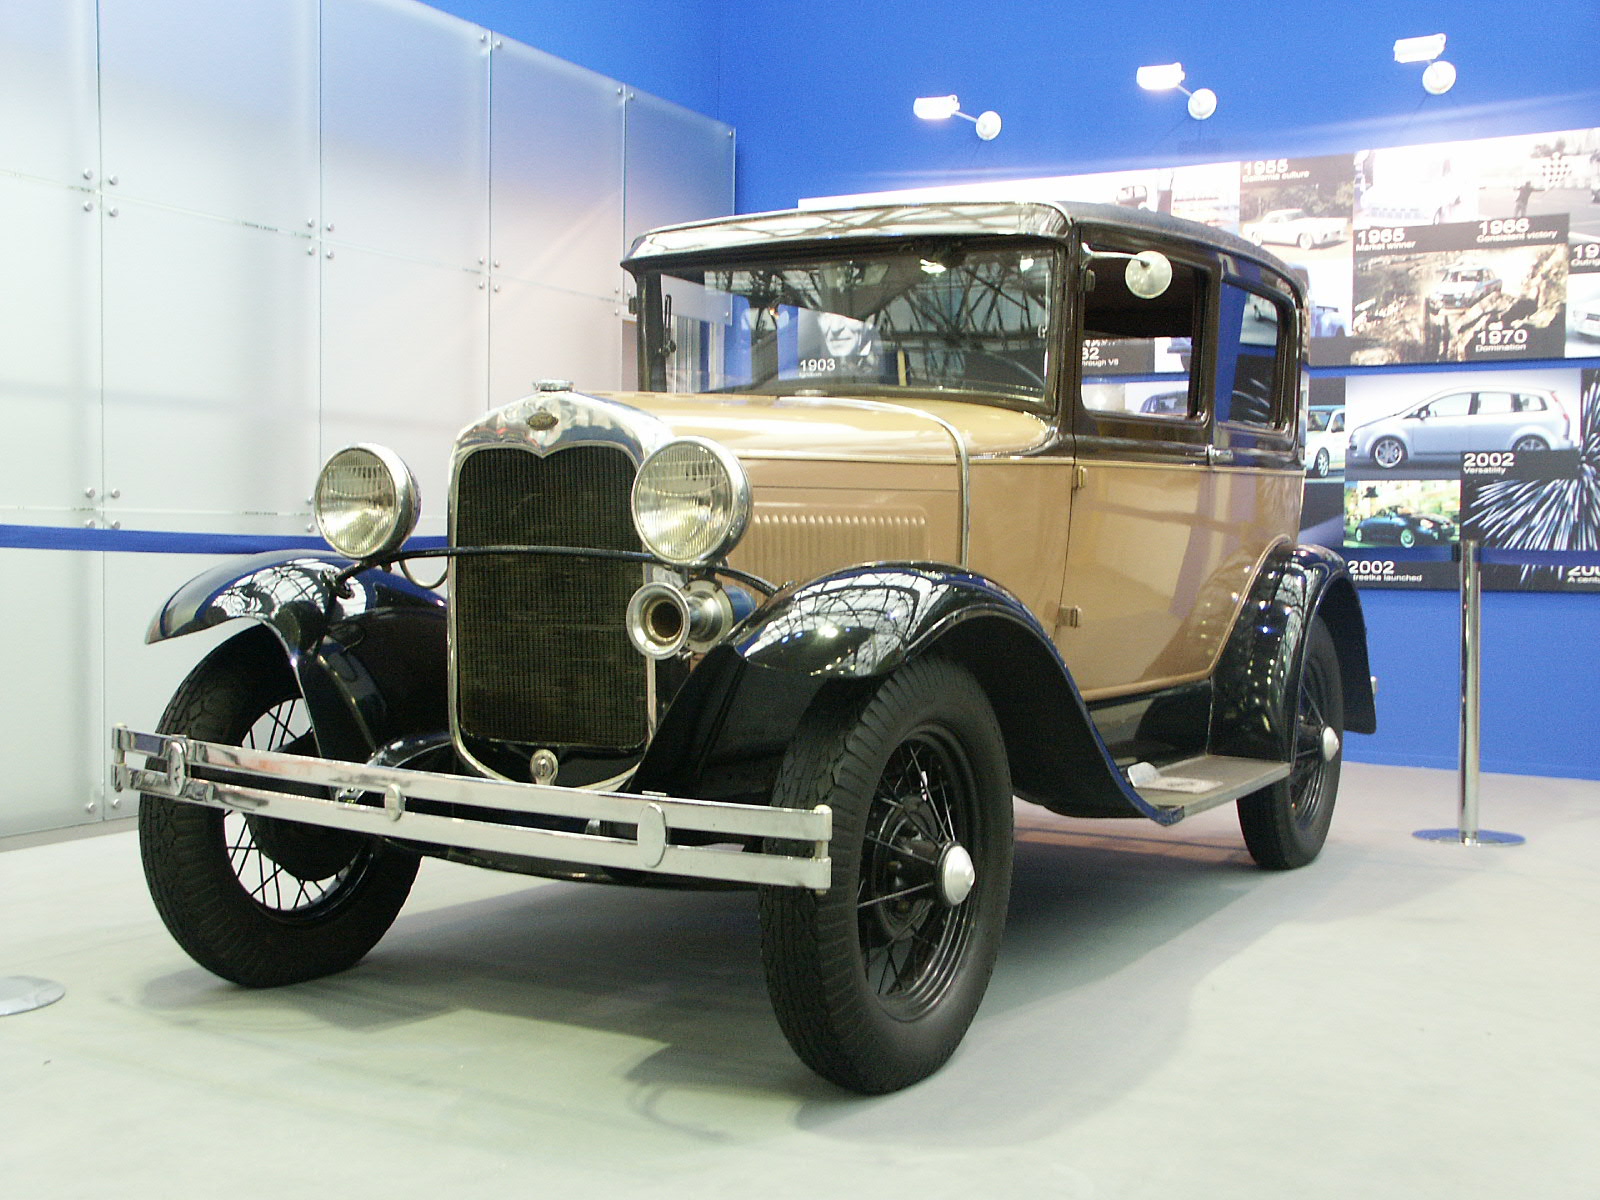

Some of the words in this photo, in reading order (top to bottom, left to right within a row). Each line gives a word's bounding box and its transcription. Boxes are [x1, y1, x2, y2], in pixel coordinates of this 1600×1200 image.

[1479, 218, 1530, 235] 1966
[1476, 232, 1526, 243] Consistent
[1526, 230, 1558, 239] victory
[1355, 242, 1386, 252] Market
[1386, 240, 1417, 250] winner
[1477, 329, 1527, 345] 1970
[1475, 343, 1527, 353] Domination
[800, 358, 836, 372] 1903
[1463, 452, 1515, 467] 2002
[1463, 466, 1507, 476] Versatility
[1347, 560, 1395, 575] 2002
[1353, 574, 1382, 582] treetka
[1383, 574, 1422, 582] launched
